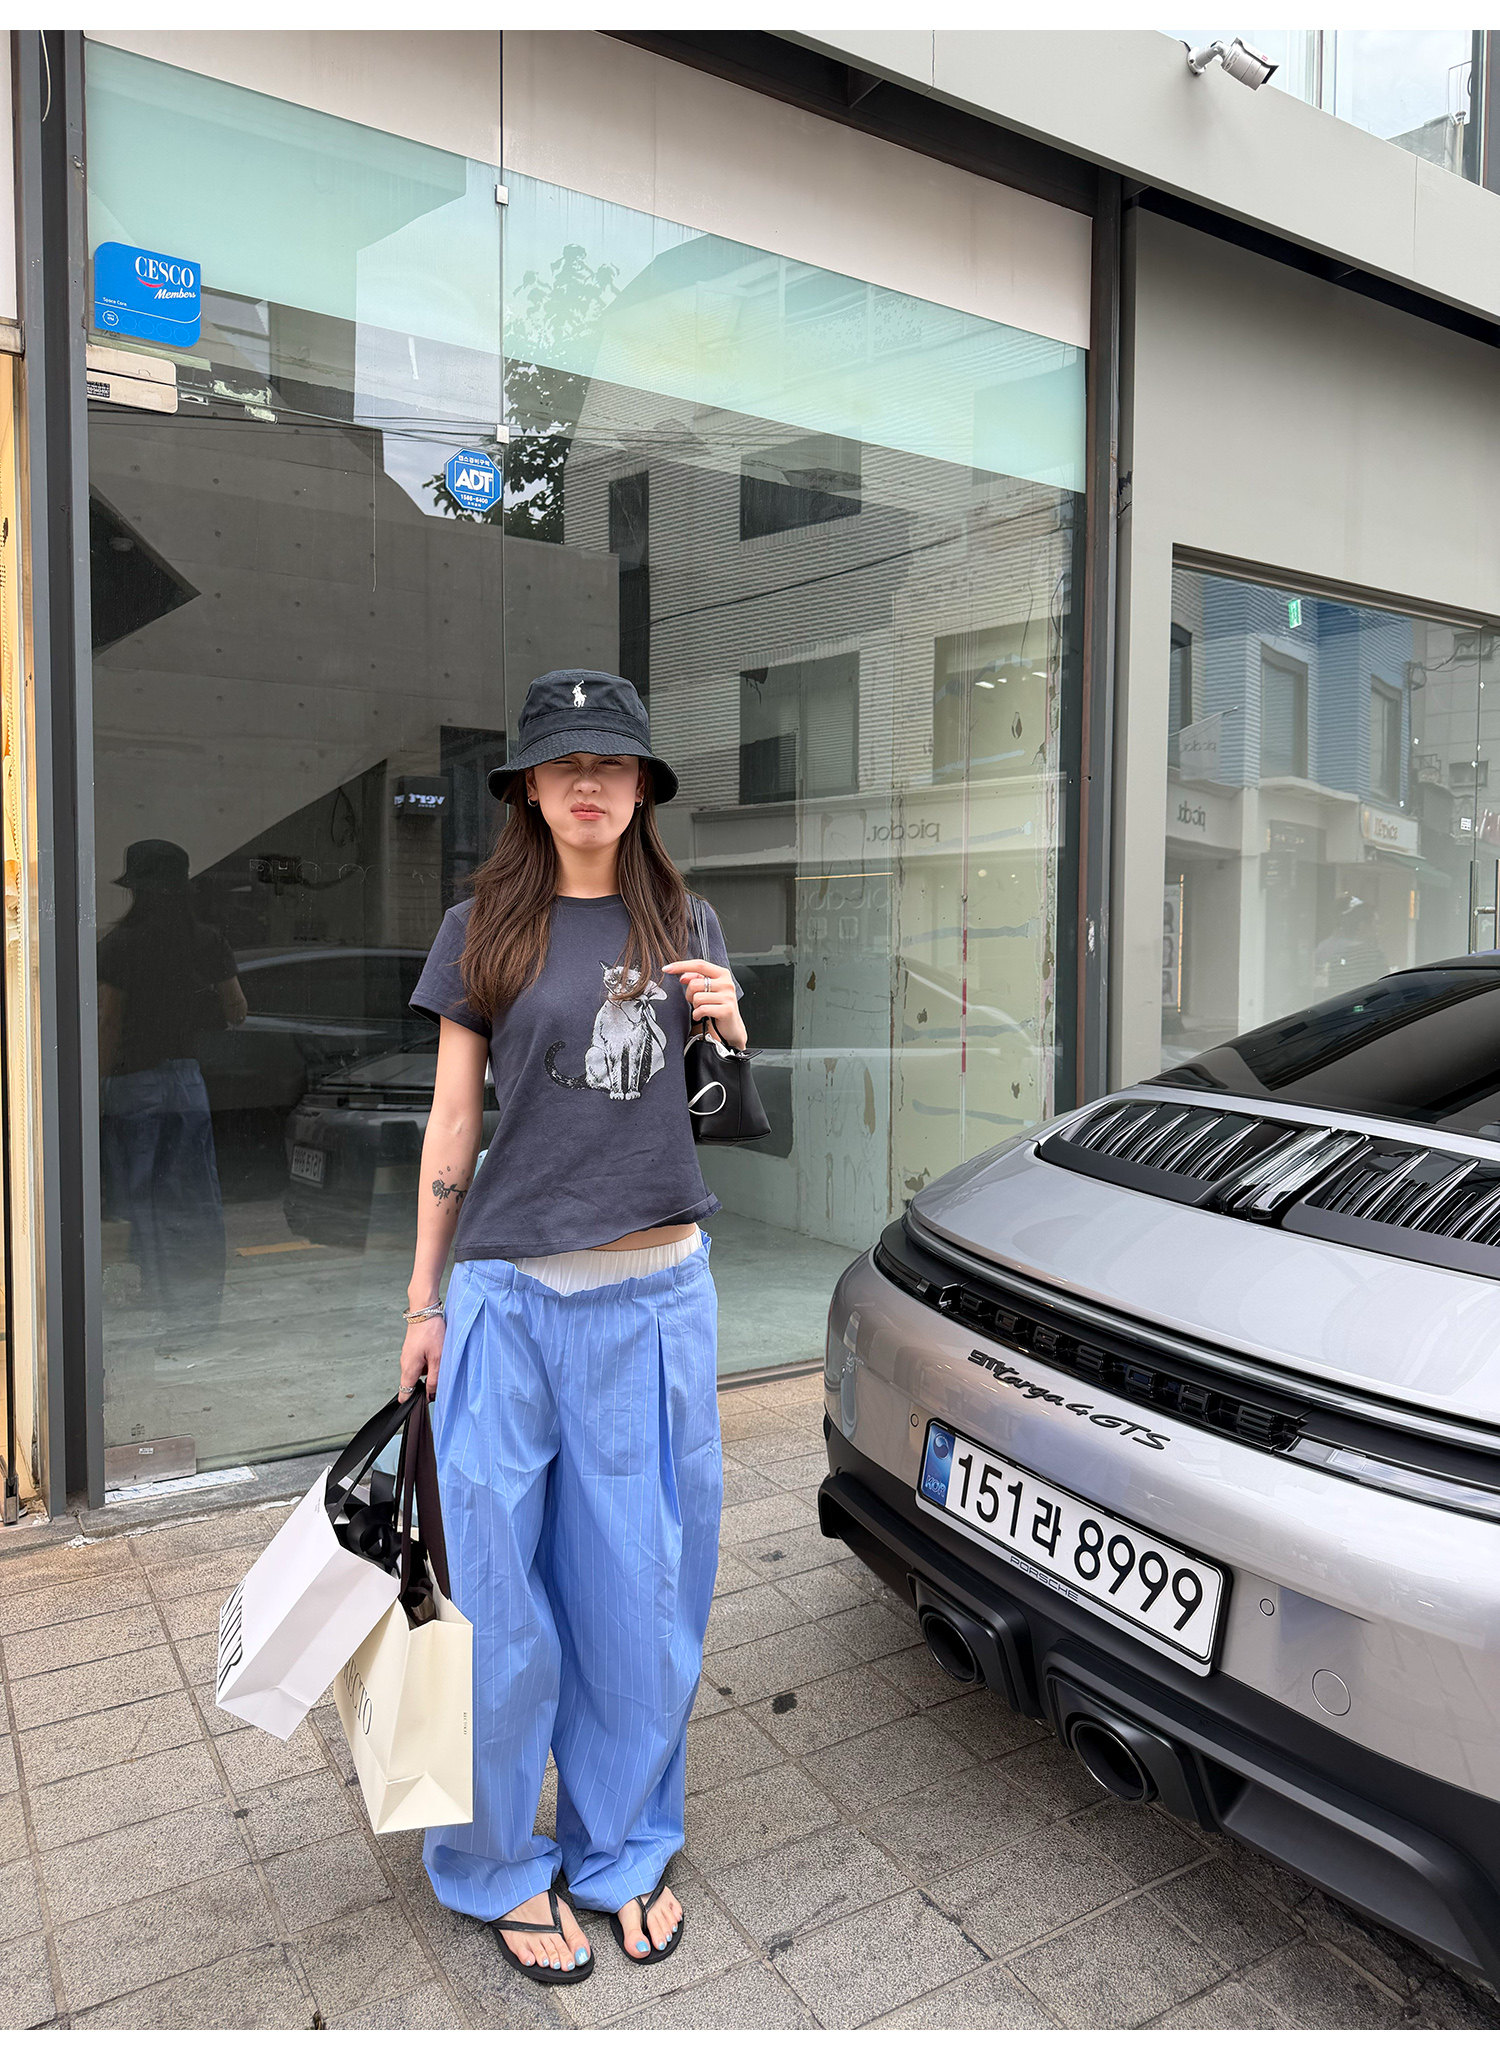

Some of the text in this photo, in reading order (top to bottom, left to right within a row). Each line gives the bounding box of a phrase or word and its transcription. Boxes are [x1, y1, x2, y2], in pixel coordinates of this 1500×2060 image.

[135, 256, 194, 288] CESCO
[154, 288, 196, 300] Members
[456, 468, 493, 493] ADT
[960, 1292, 1274, 1436] PORSCHE
[1065, 1403, 1094, 1416] 4
[1089, 1414, 1171, 1450] GTS
[925, 1474, 947, 1498] KOR
[959, 1453, 1204, 1632] 151라 8999
[1010, 1555, 1079, 1602] PORSCHE
